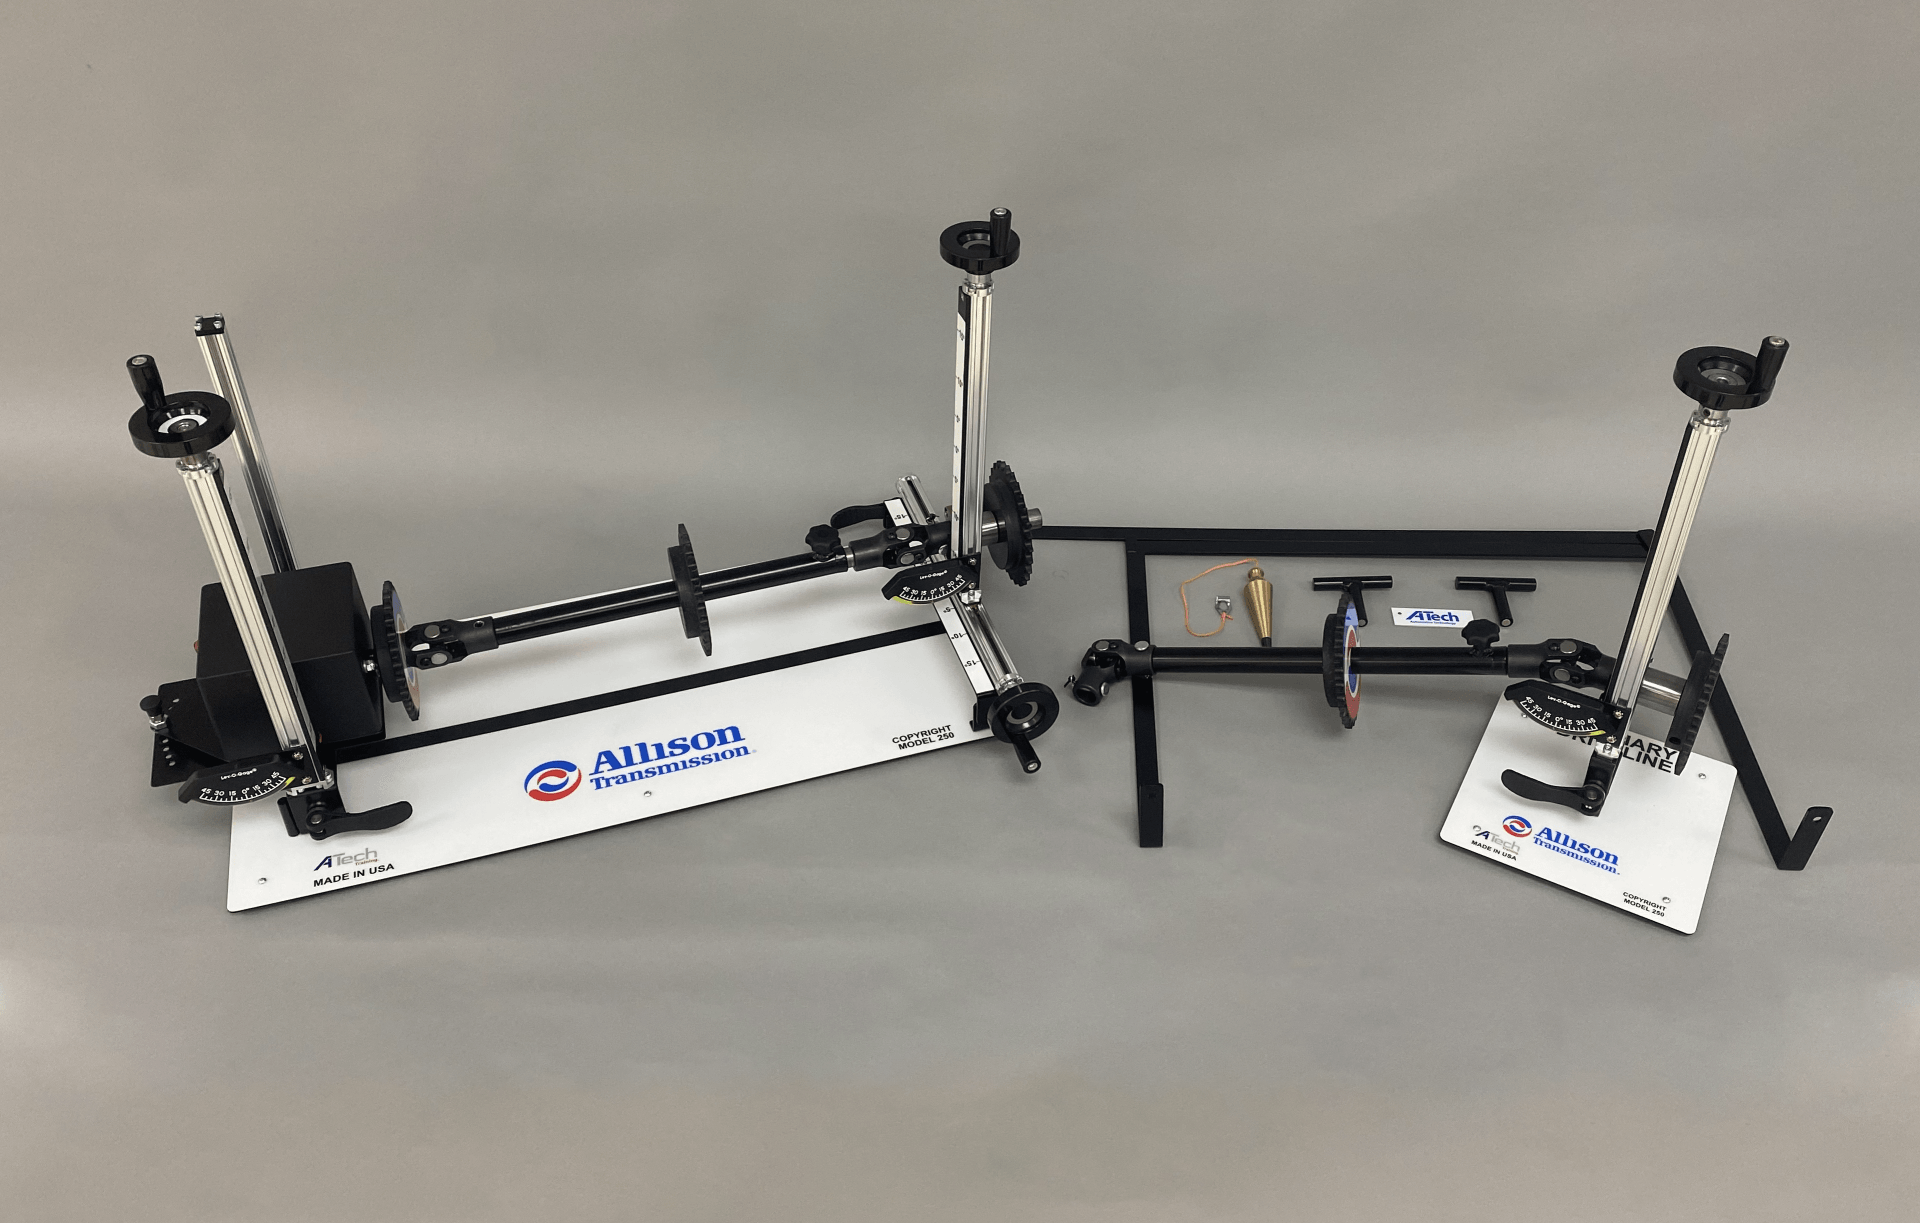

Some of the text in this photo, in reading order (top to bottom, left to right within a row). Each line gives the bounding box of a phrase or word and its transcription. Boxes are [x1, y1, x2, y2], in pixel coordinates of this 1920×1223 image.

[1406, 610, 1460, 622] ATech
[1533, 704, 1543, 712] 30
[892, 724, 951, 744] COPYRIGHT
[898, 732, 955, 750] MODEL 250
[589, 725, 746, 776] Allison
[271, 771, 280, 779] 45
[589, 745, 751, 790] Transmission
[1471, 840, 1492, 851] MADE
[1502, 852, 1517, 861] USA
[1533, 836, 1618, 875] Transmission
[1534, 827, 1619, 866] Allison
[313, 847, 378, 871] ATech
[313, 863, 395, 887] MADE IN USA
[1623, 891, 1666, 911] COPYRIGHT
[1623, 898, 1650, 912] MODEL
